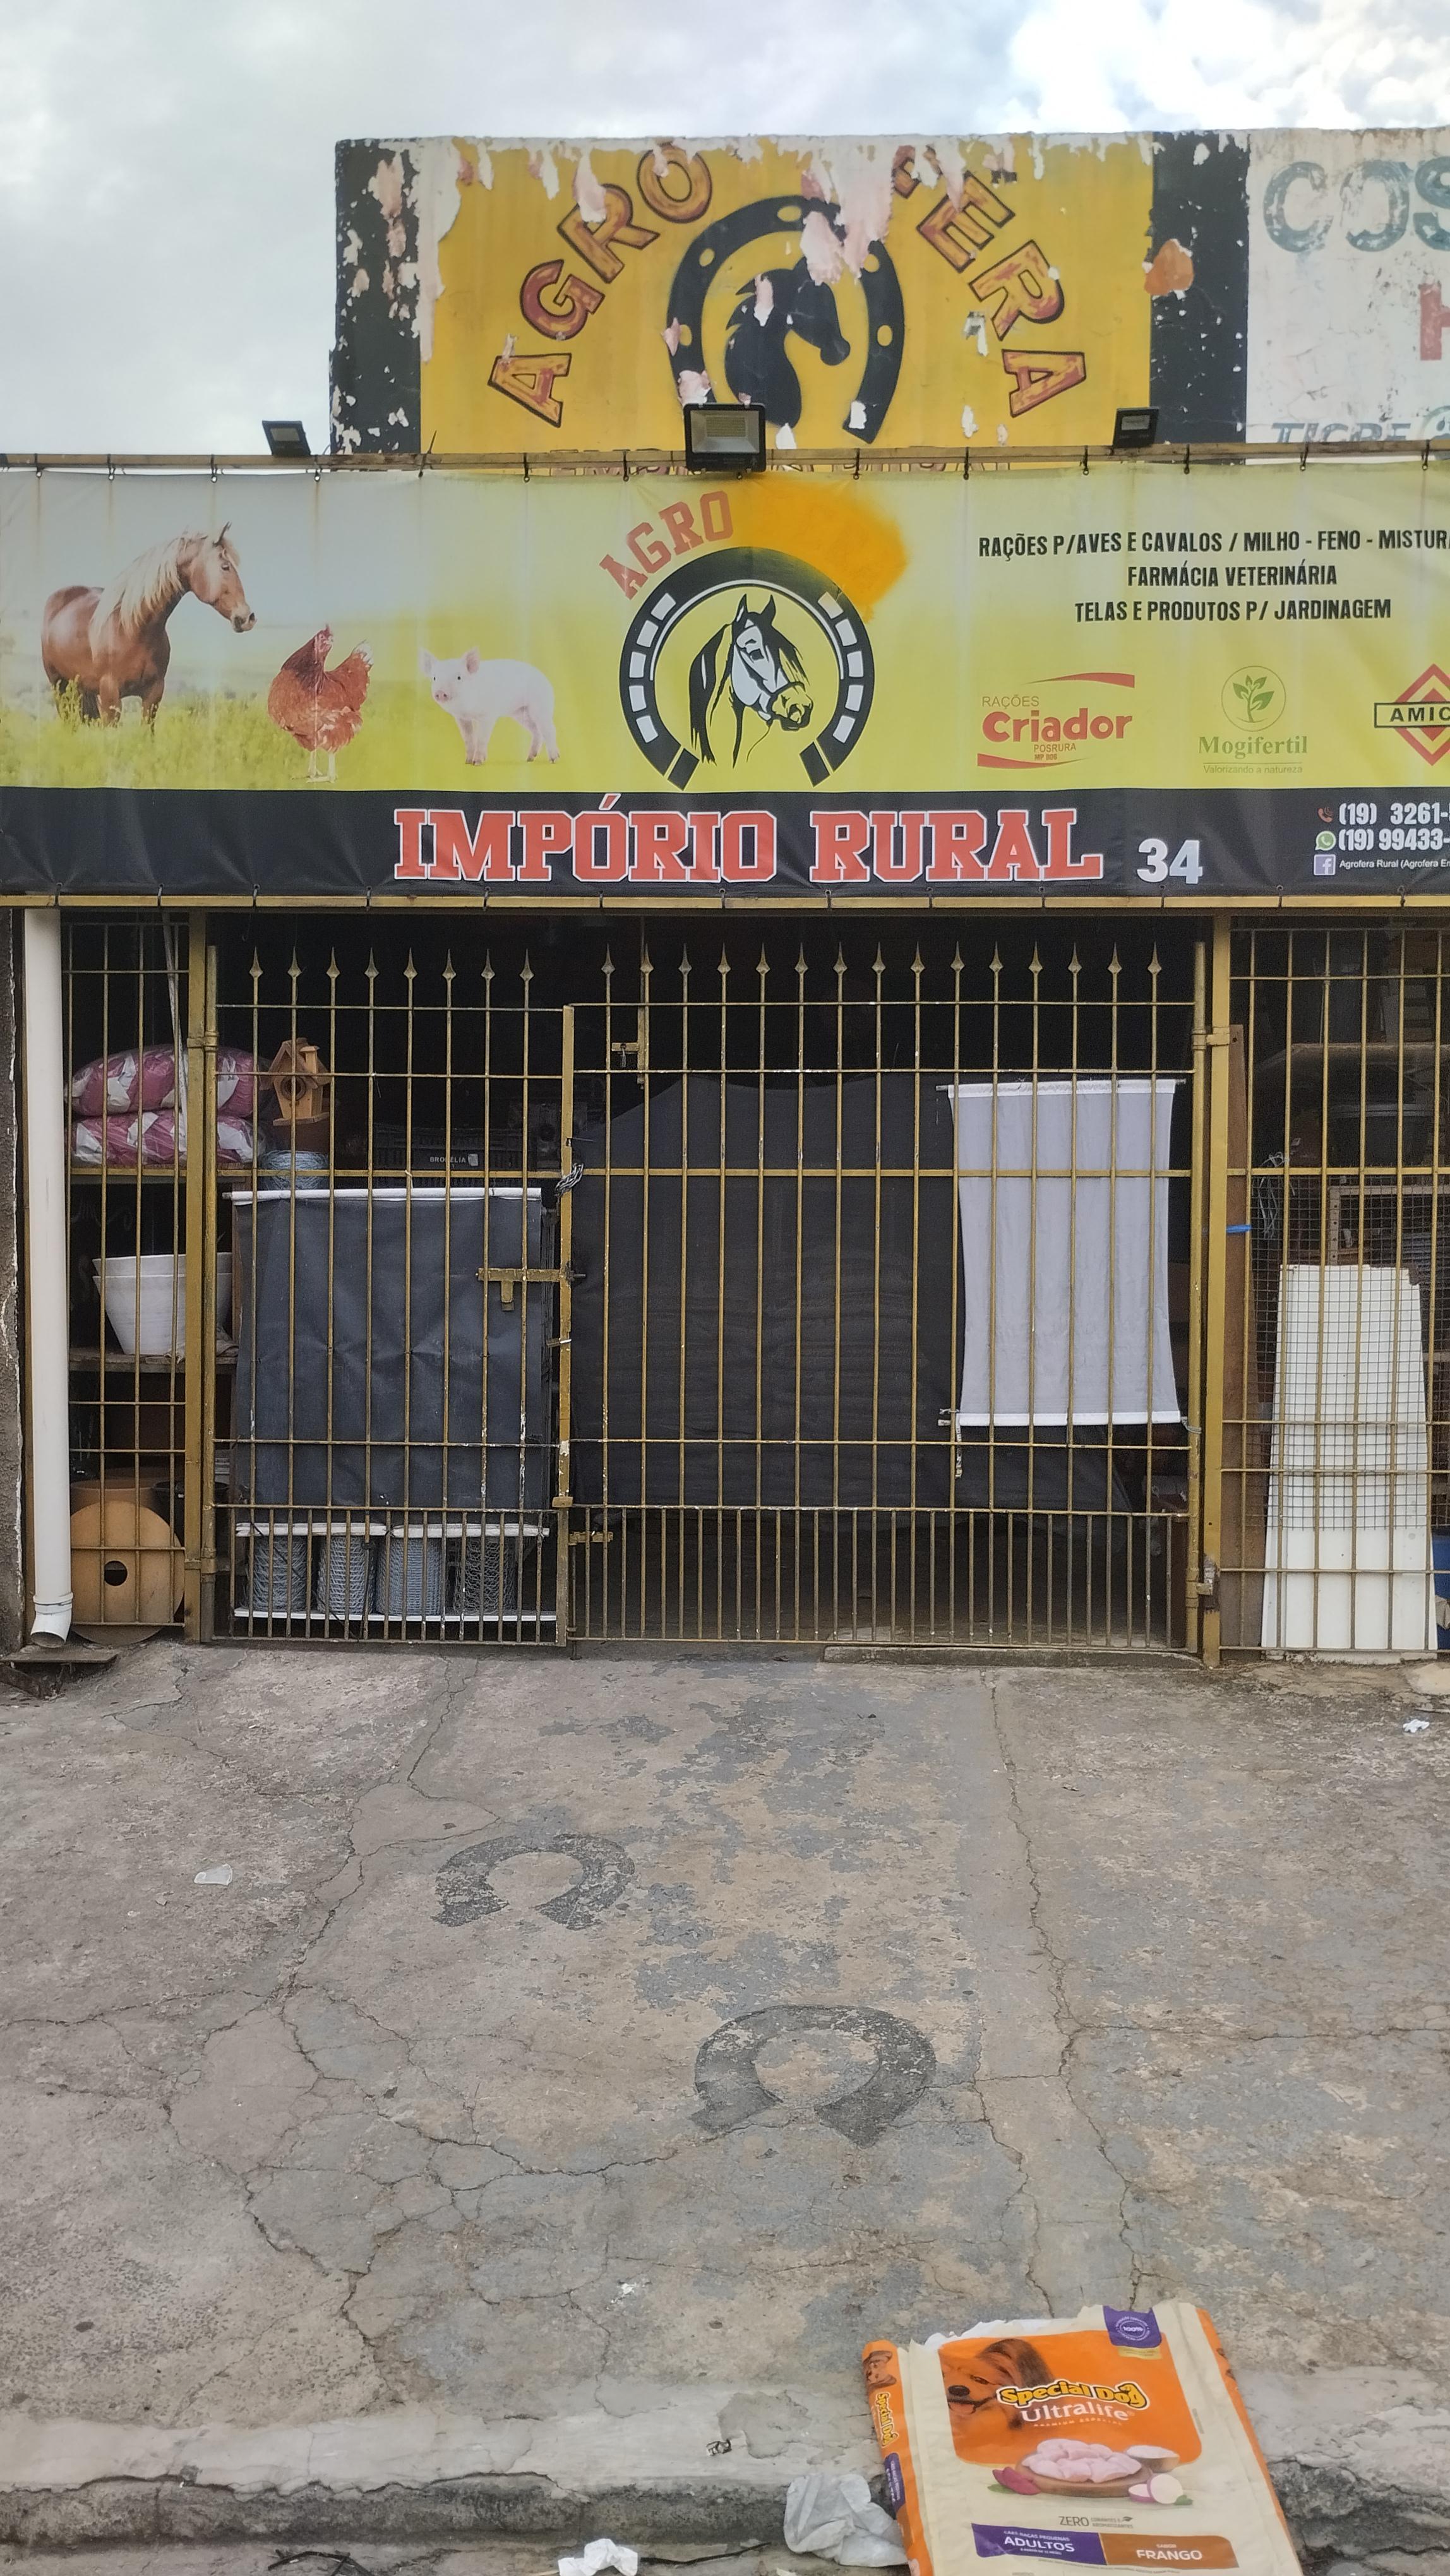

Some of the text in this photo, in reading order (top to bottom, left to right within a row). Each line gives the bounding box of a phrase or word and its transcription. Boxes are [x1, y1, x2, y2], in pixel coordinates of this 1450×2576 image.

[488, 143, 711, 427] AGRO
[599, 491, 734, 600] AGRO
[979, 533, 1048, 561] RAÇÕES
[1127, 532, 1137, 551] E
[1141, 532, 1223, 552] CAVALOS
[1243, 531, 1300, 552] MILHO
[1317, 530, 1361, 550] FENO
[1378, 530, 1450, 549] MISTUR
[1127, 559, 1338, 587] FARMÁCIA VETERINÁRIA
[1075, 601, 1127, 622] TELAS
[1133, 601, 1142, 621] E
[1147, 601, 1241, 622] PRODUTOS
[1273, 599, 1391, 621] JARDINAGEM
[981, 695, 1040, 710] RAÇÕES
[981, 707, 1133, 742] Criador
[1198, 736, 1309, 760] Mogifertil
[1203, 765, 1254, 773] Valorizando
[1339, 802, 1450, 825] (19) 3261-
[394, 793, 1104, 882] IMPÓRIO RURAL
[1338, 828, 1374, 850] (19)
[1136, 838, 1203, 885] 34
[1339, 859, 1374, 869] Agrofera
[1376, 859, 1399, 868] Rural
[1400, 859, 1438, 869] (Agrofera
[997, 2379, 1150, 2410] Special Dog
[1020, 2401, 1130, 2423] Ultralife
[1058, 2516, 1090, 2527] ZERO
[1004, 2536, 1076, 2552] ADULTOS
[1136, 2549, 1203, 2560] FRANGO
